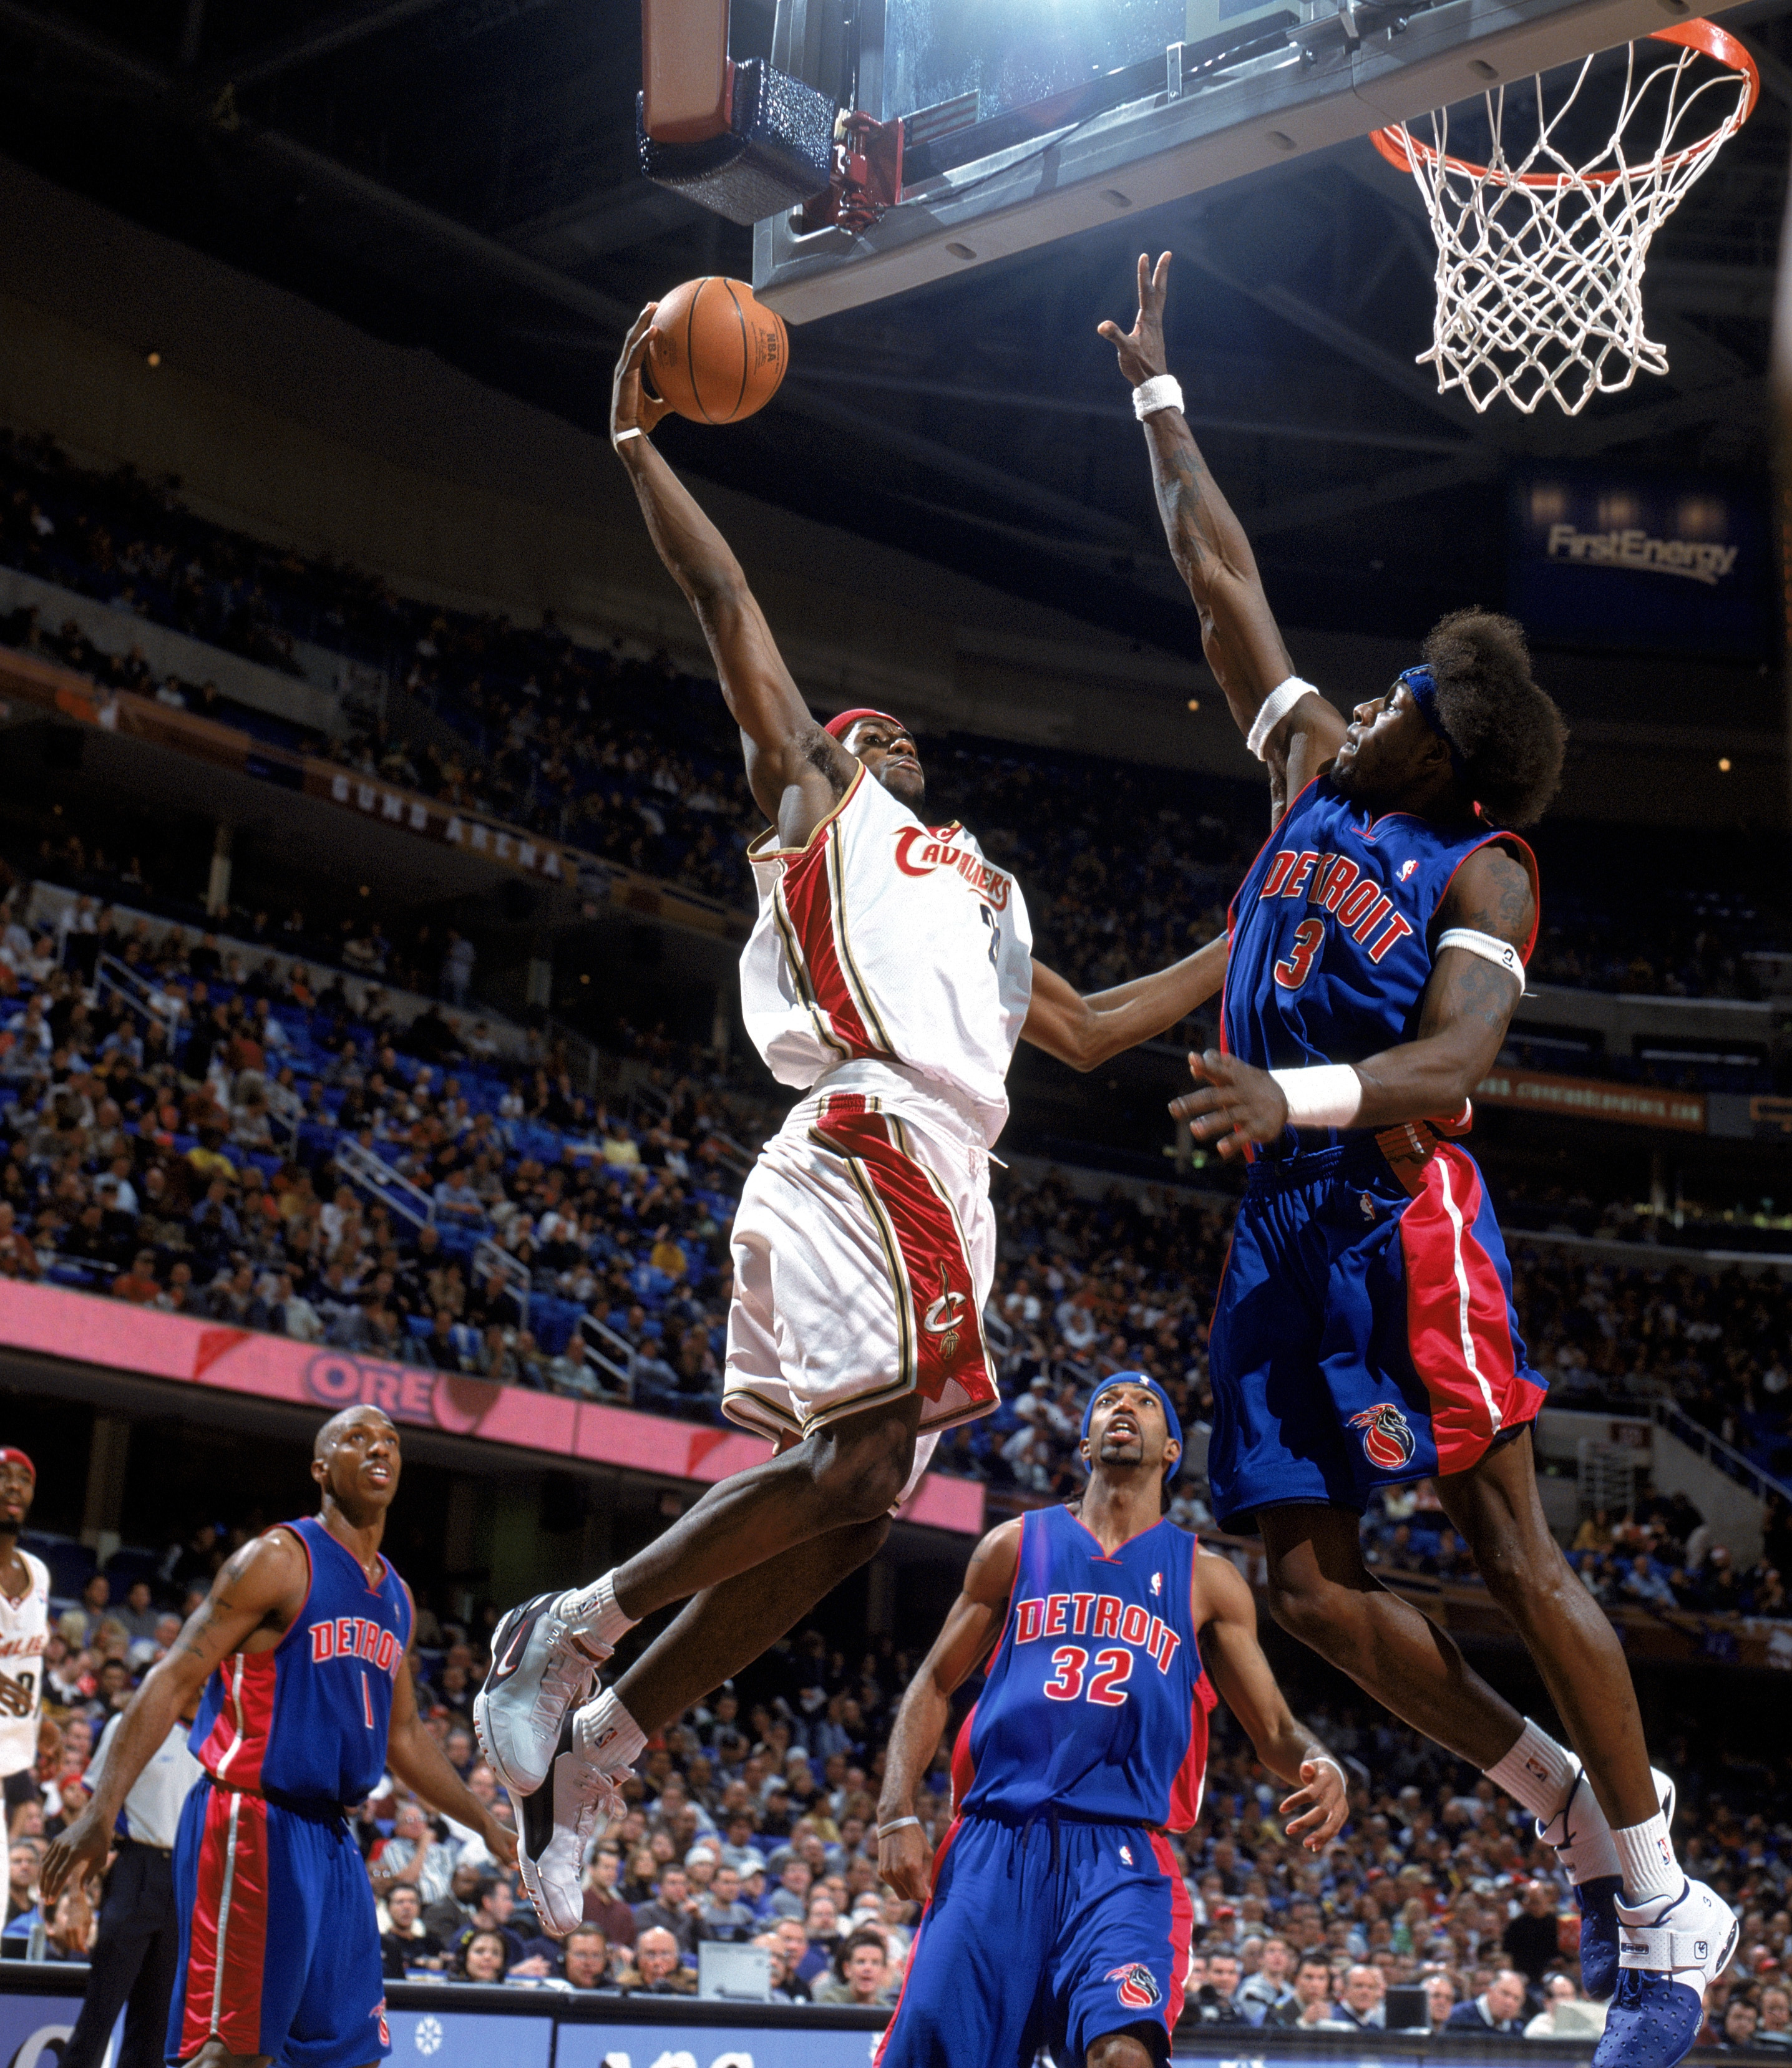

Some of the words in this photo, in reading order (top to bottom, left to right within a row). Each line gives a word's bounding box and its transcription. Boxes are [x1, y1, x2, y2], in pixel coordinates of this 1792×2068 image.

[766, 333, 777, 362] NBA
[1547, 525, 1739, 577] FirstEnergy
[890, 825, 1011, 912] CAVALIERS
[1259, 850, 1413, 964] DETROIT
[1273, 918, 1325, 989] 3
[1015, 1592, 1181, 1675] DETROIT
[360, 1669, 374, 1730] 1
[1043, 1644, 1134, 1707] 32
